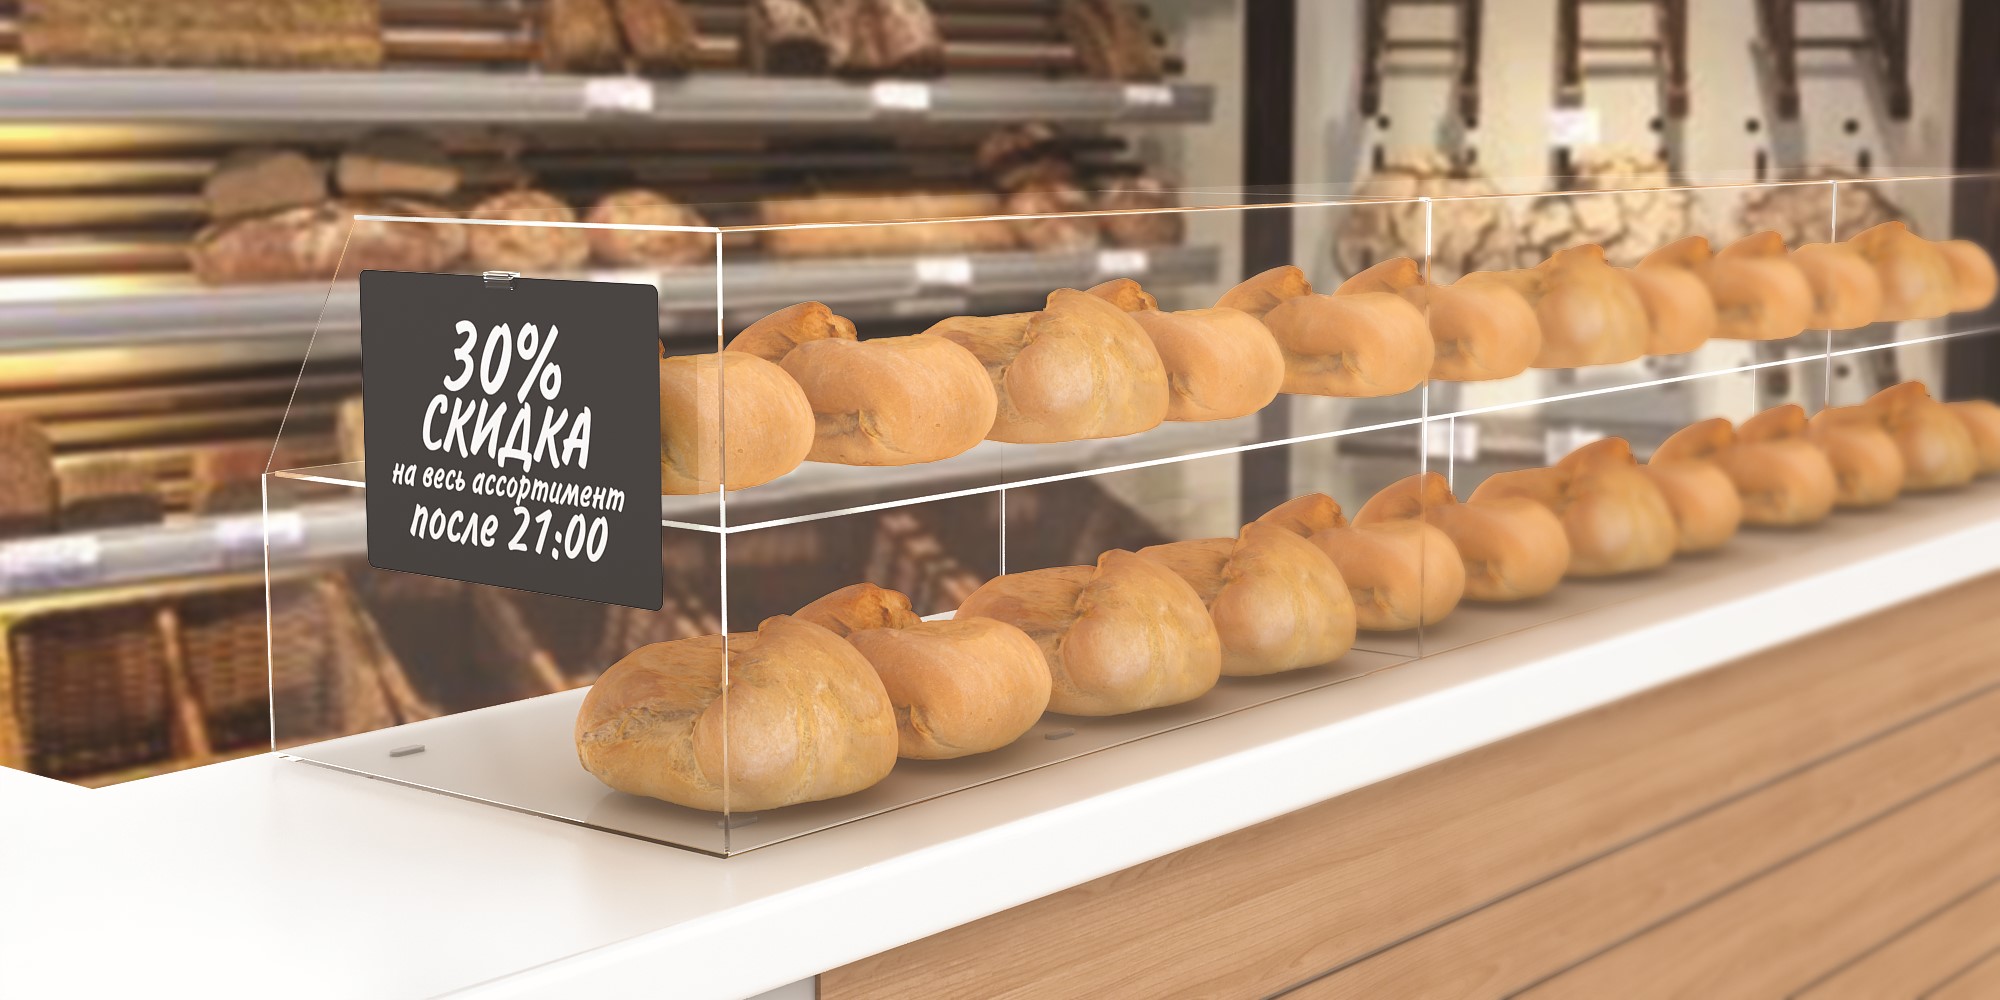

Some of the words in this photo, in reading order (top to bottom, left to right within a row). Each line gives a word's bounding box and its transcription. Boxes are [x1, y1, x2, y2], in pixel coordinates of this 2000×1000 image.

[443, 319, 562, 404] 30%
[422, 393, 592, 473] СКИДКА
[391, 462, 418, 487] на
[422, 466, 466, 492] весь
[472, 472, 626, 513] ассортимент
[409, 503, 499, 548] после
[507, 505, 609, 563] 21:00
